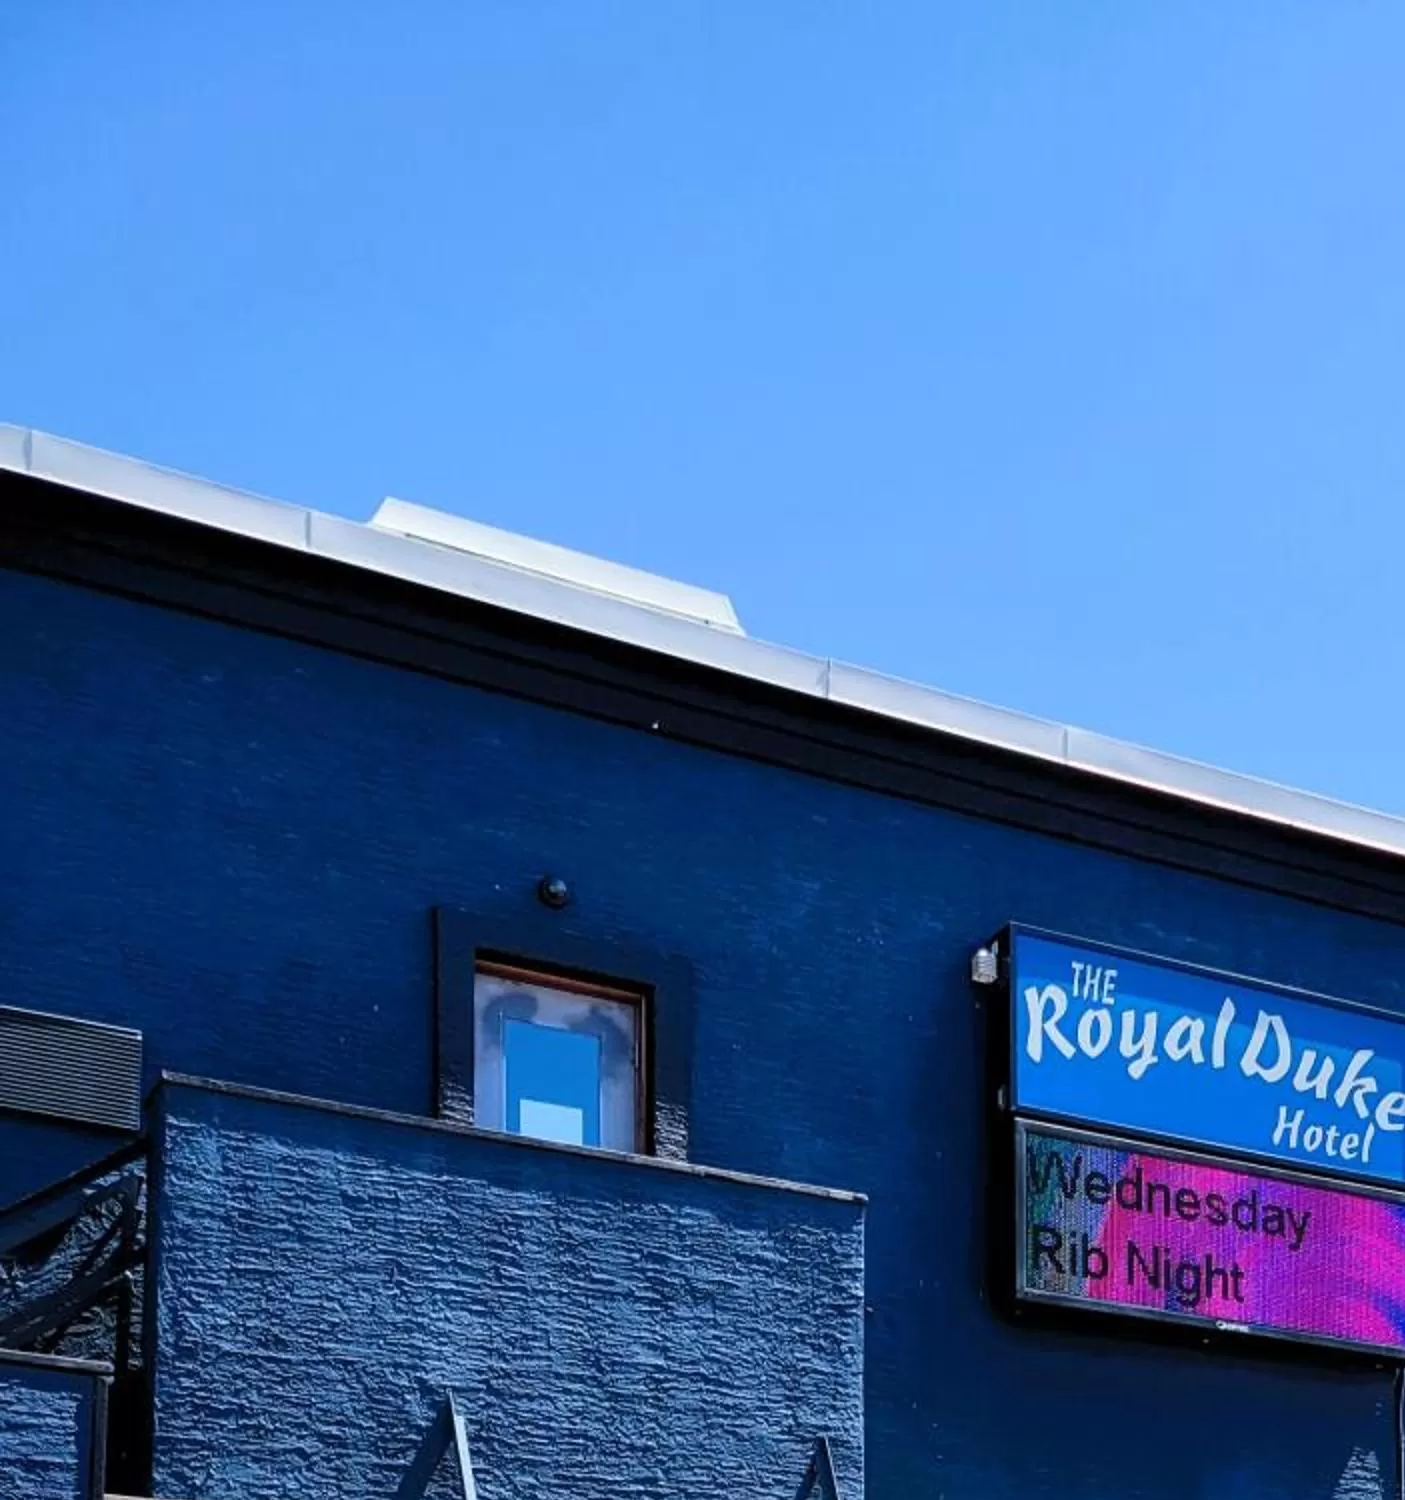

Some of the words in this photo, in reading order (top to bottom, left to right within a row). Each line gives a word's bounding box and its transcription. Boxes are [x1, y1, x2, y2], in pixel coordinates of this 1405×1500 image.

[1071, 960, 1118, 1005] THE
[1024, 983, 1236, 1080] Royal
[1271, 1104, 1375, 1164] Hotel
[1028, 1149, 1311, 1251] Wednesday
[1031, 1223, 1109, 1280] Rib
[1126, 1239, 1245, 1308] Night
